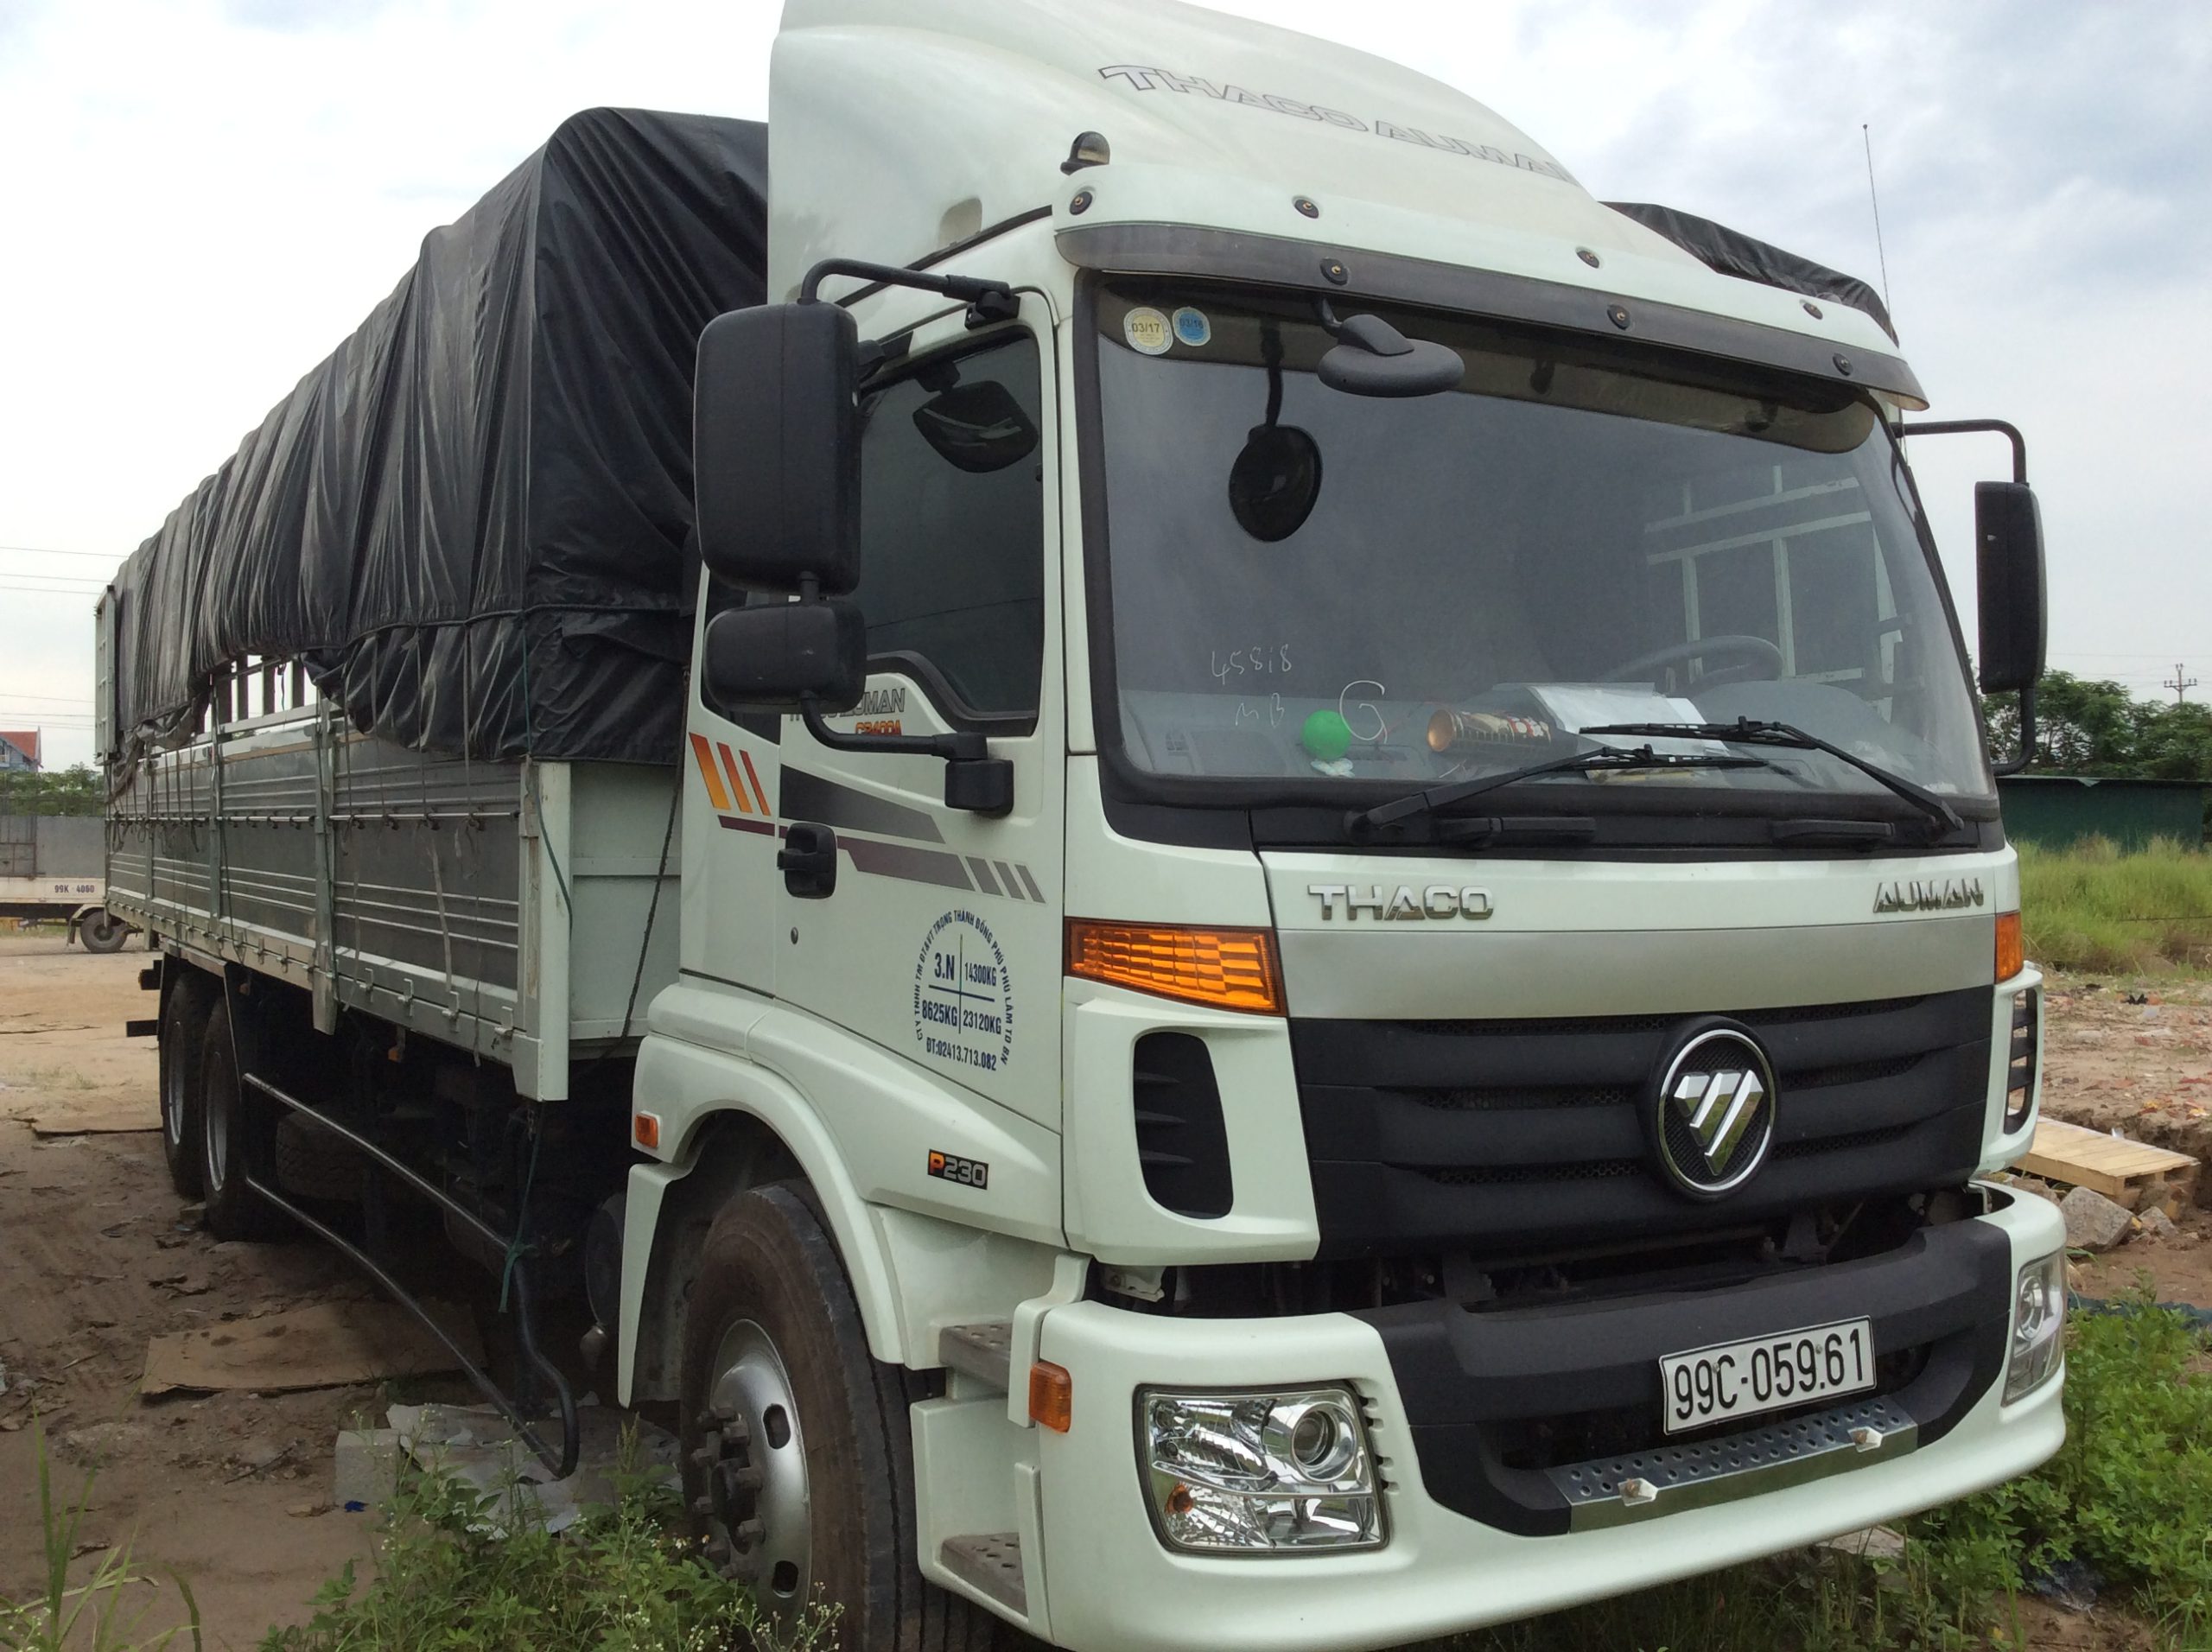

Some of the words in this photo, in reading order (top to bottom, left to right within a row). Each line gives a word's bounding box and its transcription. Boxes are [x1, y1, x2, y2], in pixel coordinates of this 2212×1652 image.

[1098, 64, 1369, 132] THACO
[1131, 323, 1160, 334] 03/17
[1307, 884, 1494, 921] THACO
[1872, 878, 1985, 913] AUMAN
[916, 963, 924, 981] TM
[964, 962, 997, 987] 14300KG
[922, 999, 957, 1026] 8625KG
[963, 1009, 1001, 1035] 23120KG
[929, 1151, 987, 1187] P230
[1674, 1328, 1864, 1420] 99C-059.61
